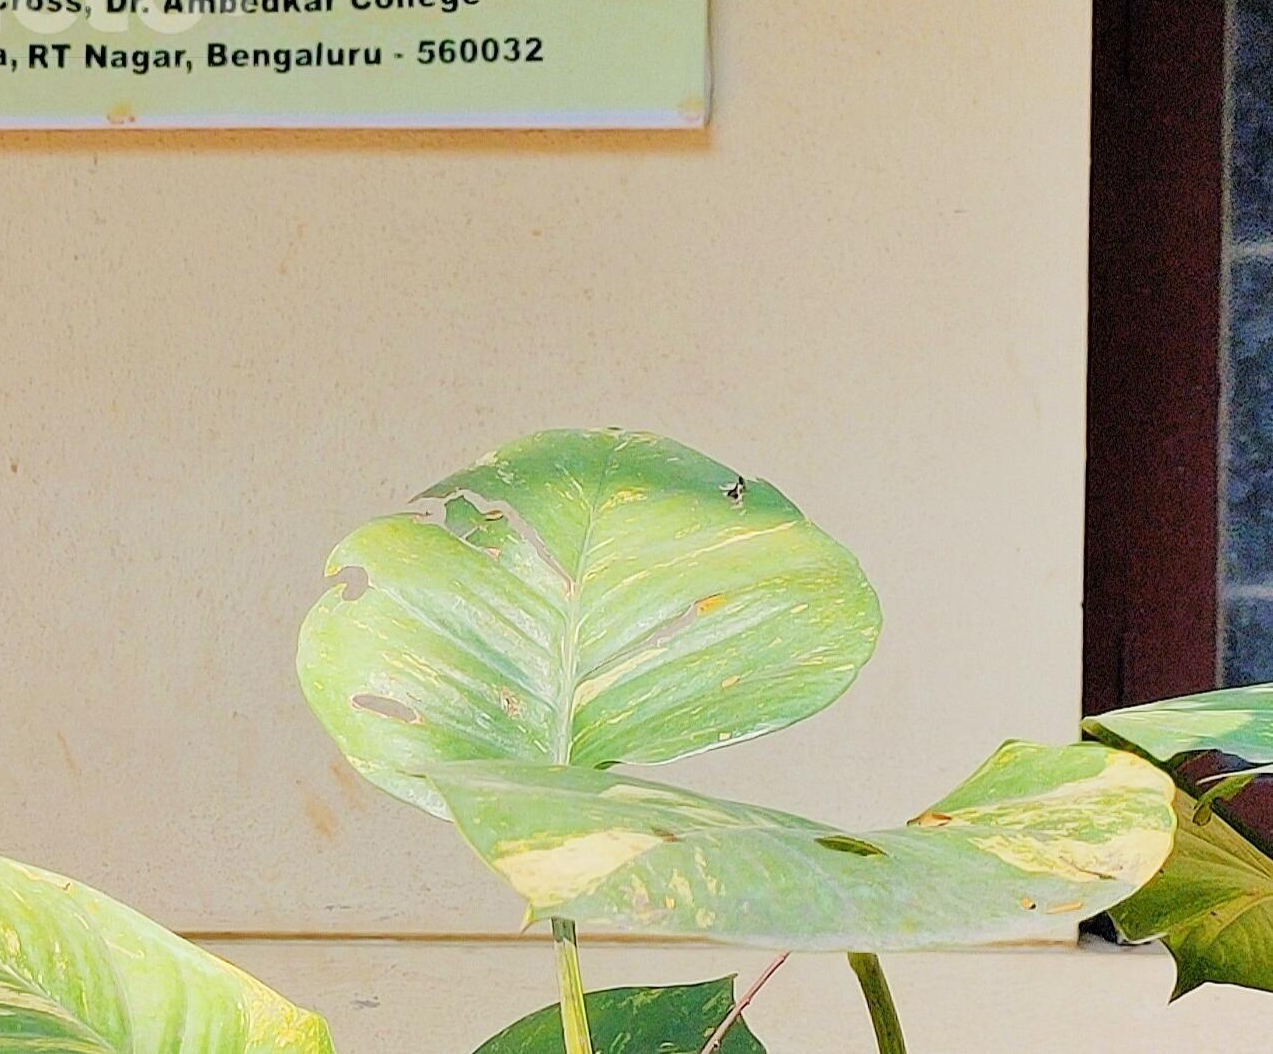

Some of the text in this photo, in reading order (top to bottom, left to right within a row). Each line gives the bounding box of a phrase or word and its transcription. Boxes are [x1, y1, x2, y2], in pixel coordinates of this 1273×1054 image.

[28, 43, 72, 69] RT
[85, 43, 193, 75] Nagar,
[207, 41, 382, 74] Bengaluru
[417, 36, 544, 65] 560032
